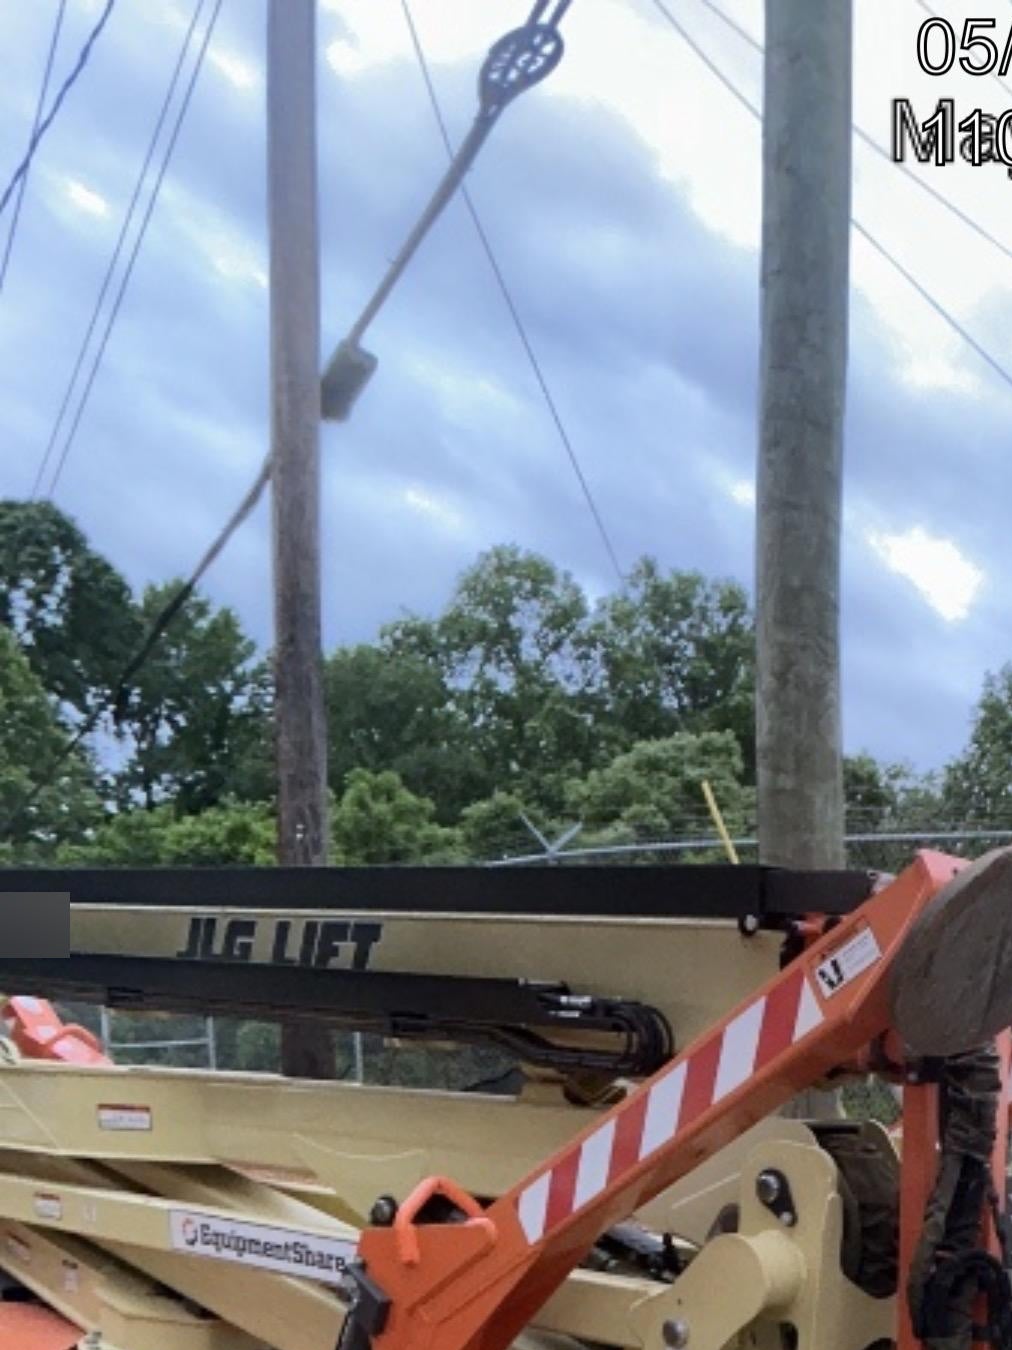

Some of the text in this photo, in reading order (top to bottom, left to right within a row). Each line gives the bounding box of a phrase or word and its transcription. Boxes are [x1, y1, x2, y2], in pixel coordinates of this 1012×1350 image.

[176, 917, 382, 970] JLG LIFT
[199, 1222, 347, 1274] EquipmentShare
